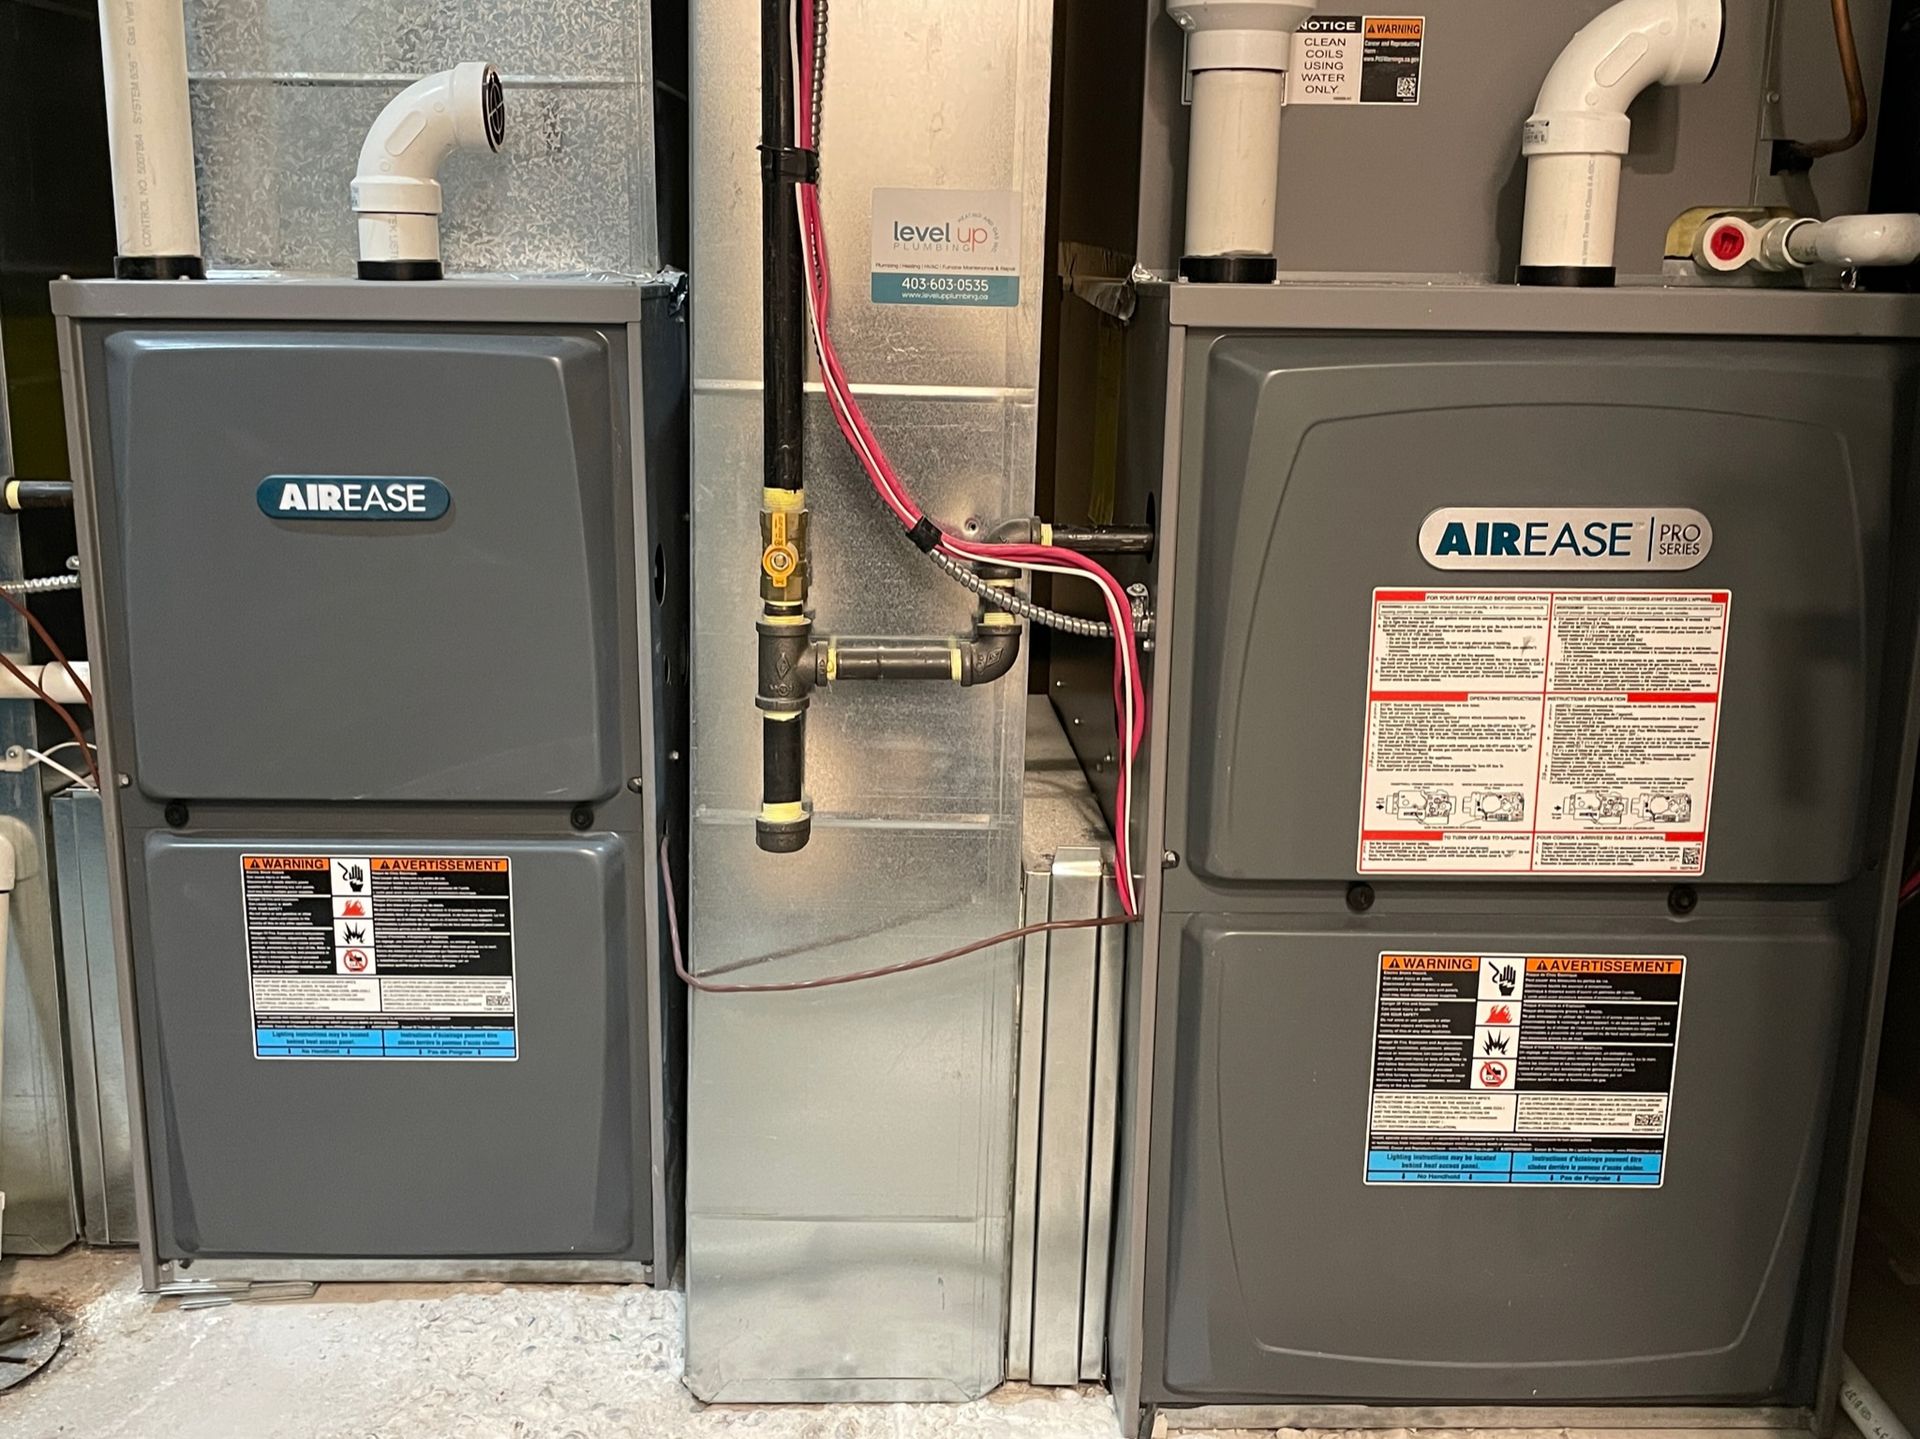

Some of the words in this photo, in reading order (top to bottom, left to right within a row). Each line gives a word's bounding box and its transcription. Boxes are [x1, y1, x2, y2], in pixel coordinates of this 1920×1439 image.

[1377, 24, 1420, 34] WARNING
[1304, 38, 1346, 46] CLEAN
[1306, 50, 1343, 58] COILS
[1304, 62, 1344, 70] USING
[1302, 74, 1345, 82] WATER
[130, 82, 142, 124] SYSTEM
[140, 199, 152, 248] CONTROL
[894, 221, 951, 243] level
[957, 227, 988, 253] up
[893, 243, 970, 252] PLUMBING
[279, 483, 426, 512] AIREASE
[1659, 524, 1700, 541] PRO
[1658, 543, 1700, 555] SERIES
[262, 860, 323, 868] WARNING
[392, 861, 501, 870] AVERTISSEMENT
[1403, 958, 1472, 969] WARNING
[1550, 960, 1674, 972] AVERTISSEMENT
